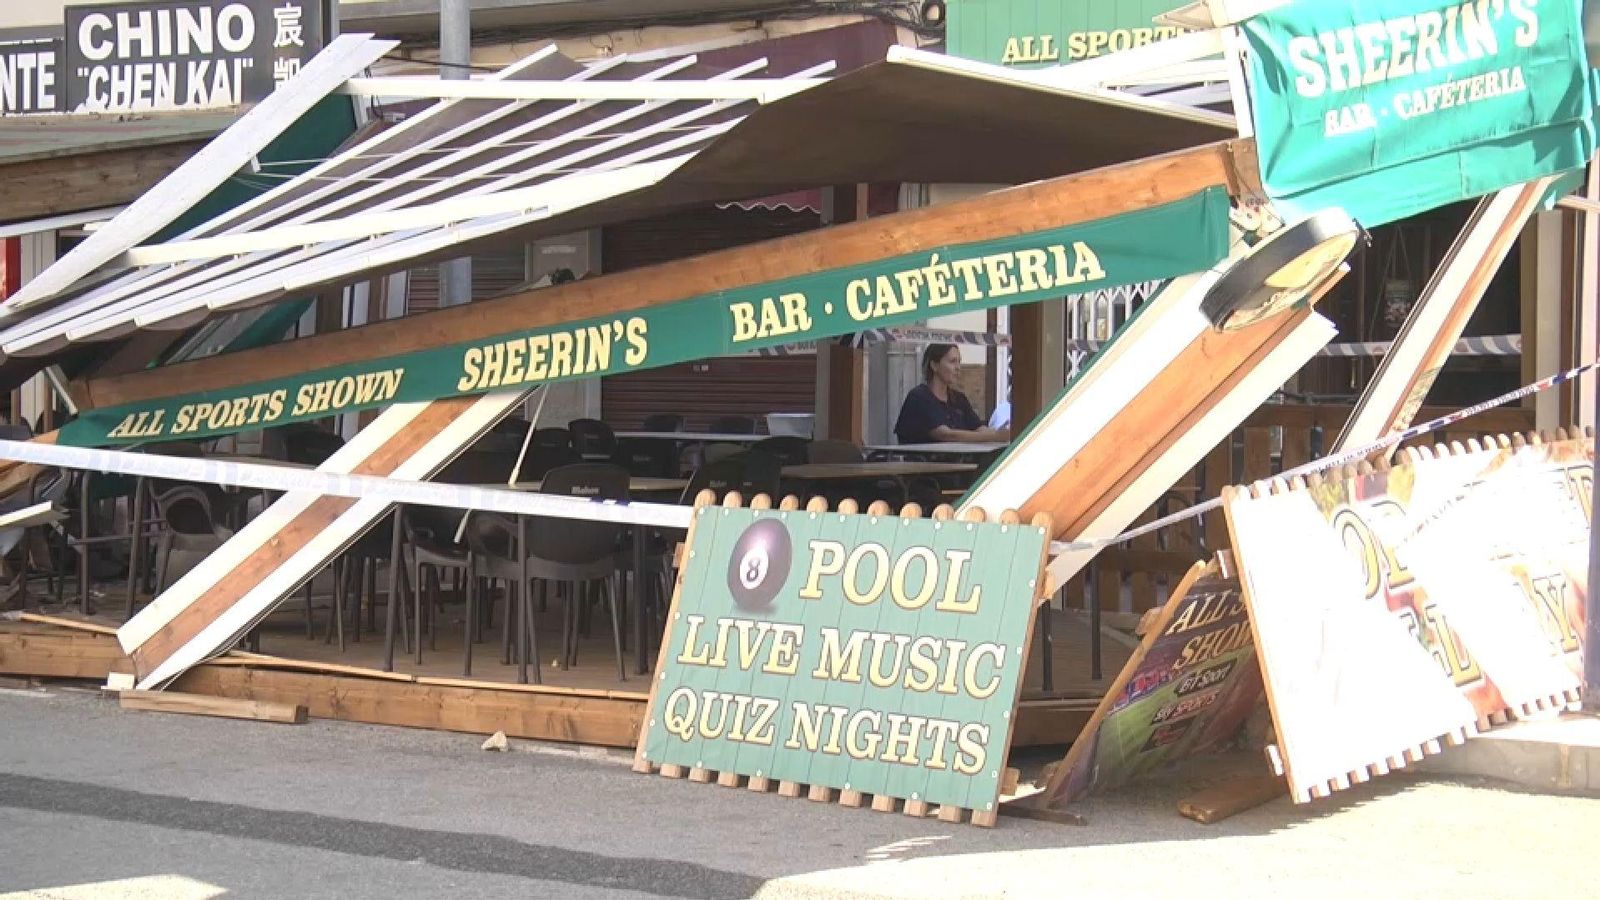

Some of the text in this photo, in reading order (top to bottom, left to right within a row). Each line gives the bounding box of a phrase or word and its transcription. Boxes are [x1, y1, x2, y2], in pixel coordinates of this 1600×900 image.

[78, 4, 255, 60] CHINO
[1002, 26, 1186, 63] ALL SPORT
[1288, 0, 1539, 97] SHEERIN'S
[1325, 66, 1526, 136] BAR CAFÉTERIA
[730, 241, 1105, 342] BAR CAFÉTERIA
[457, 316, 648, 391] SHEERIN'S
[107, 369, 405, 437] ALL SPORTS SHOWN
[745, 539, 982, 613] 8 POOL
[1165, 589, 1232, 636] ALL
[677, 614, 1007, 699] LIVE MUSIC
[663, 687, 990, 775] QUIZ NIGHTS
